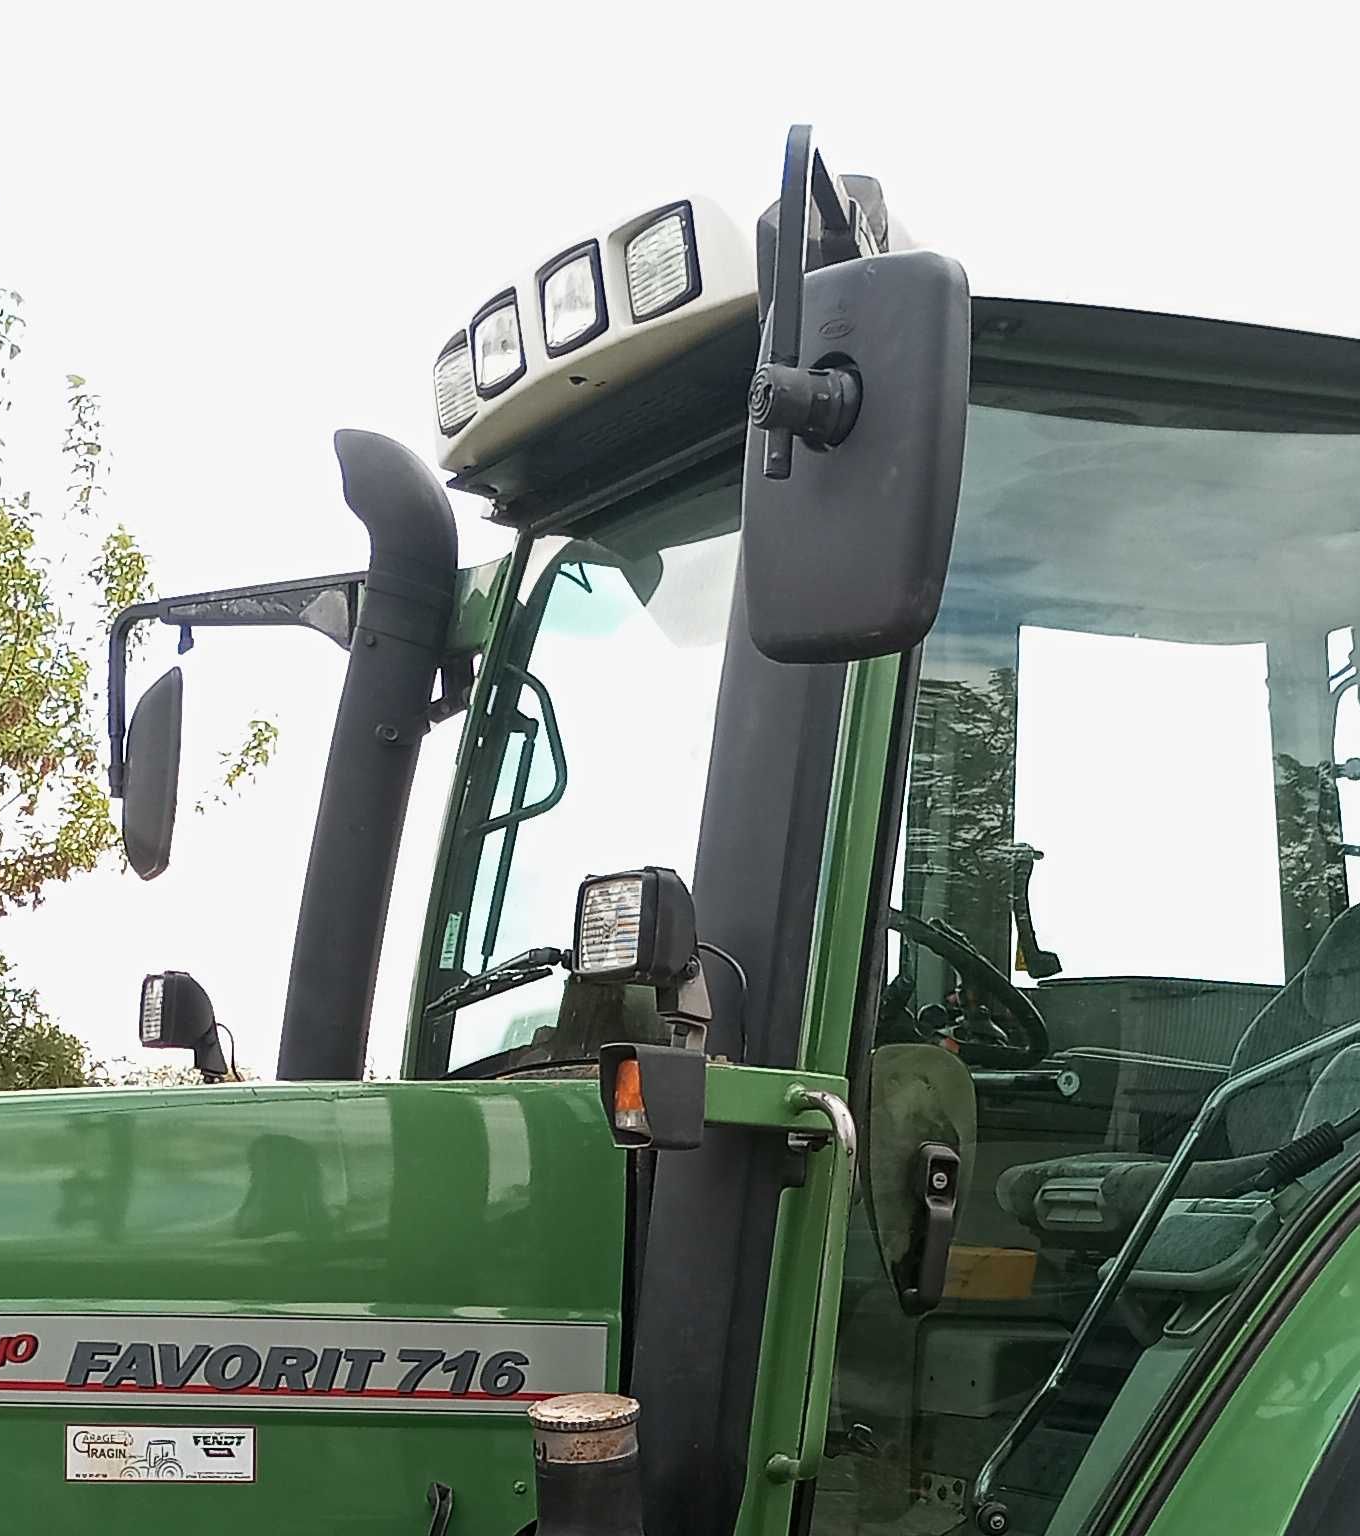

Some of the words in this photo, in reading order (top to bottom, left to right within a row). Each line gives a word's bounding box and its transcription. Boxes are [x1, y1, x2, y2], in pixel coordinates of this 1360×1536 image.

[63, 1341, 386, 1395] FAVORIT
[393, 1349, 530, 1397] 716
[192, 1435, 246, 1446] FENDT
